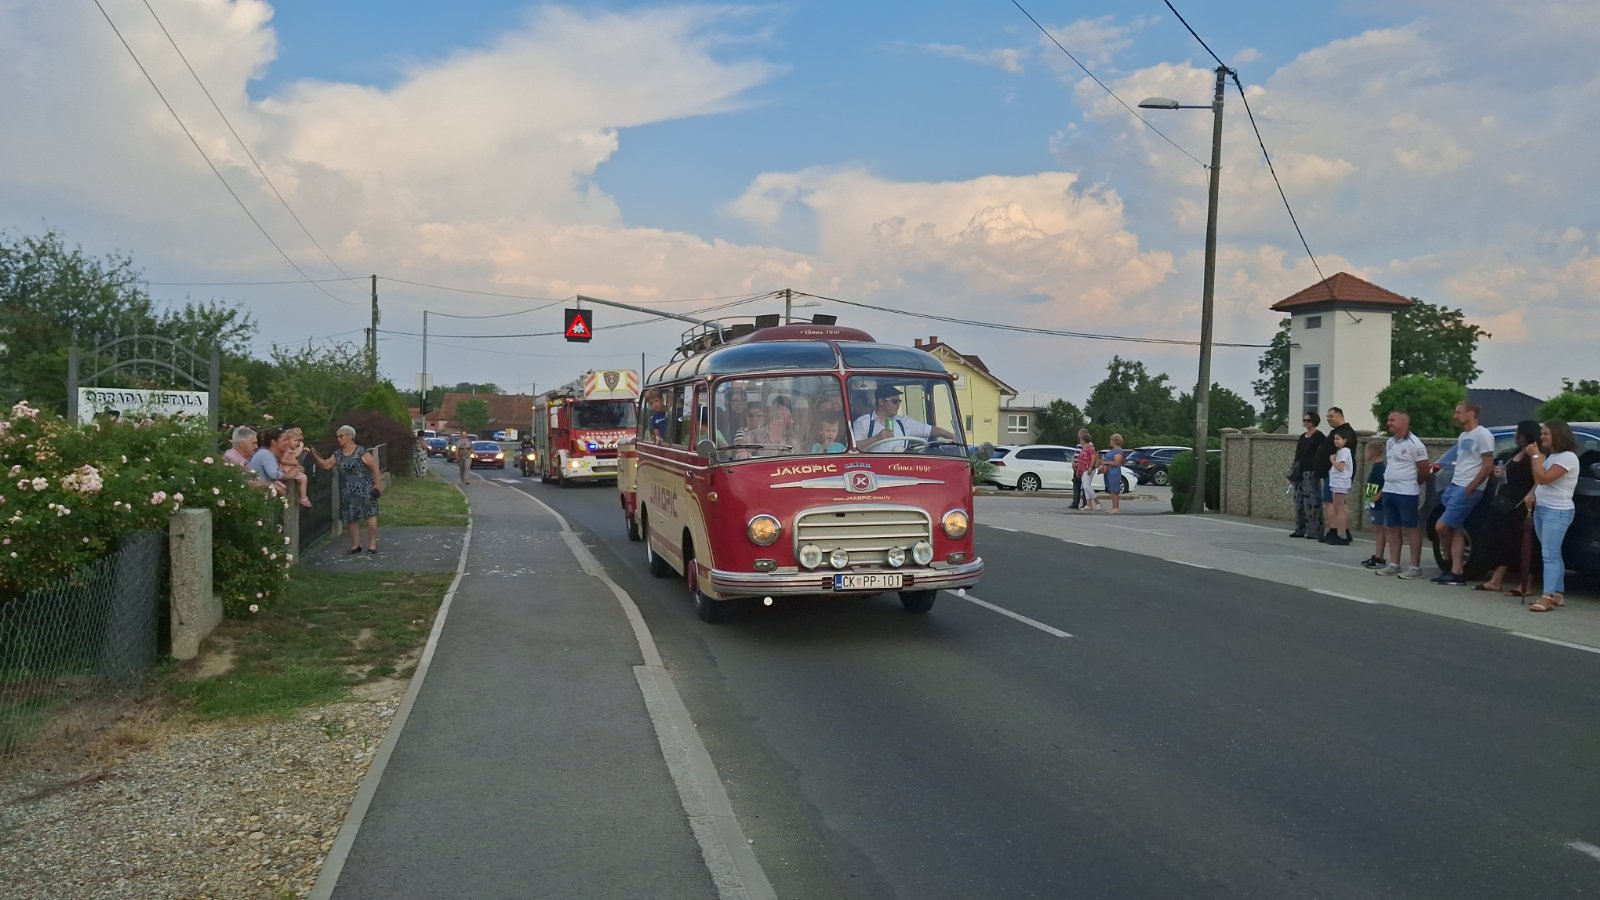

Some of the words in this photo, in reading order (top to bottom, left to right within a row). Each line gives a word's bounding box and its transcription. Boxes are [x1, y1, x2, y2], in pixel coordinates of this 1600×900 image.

[85, 390, 144, 404] OBRADA
[770, 463, 838, 477] JAKOPIĆ
[888, 462, 914, 471] Since
[915, 464, 931, 473] 1991
[842, 575, 855, 588] CK
[863, 574, 900, 587] PP-101
